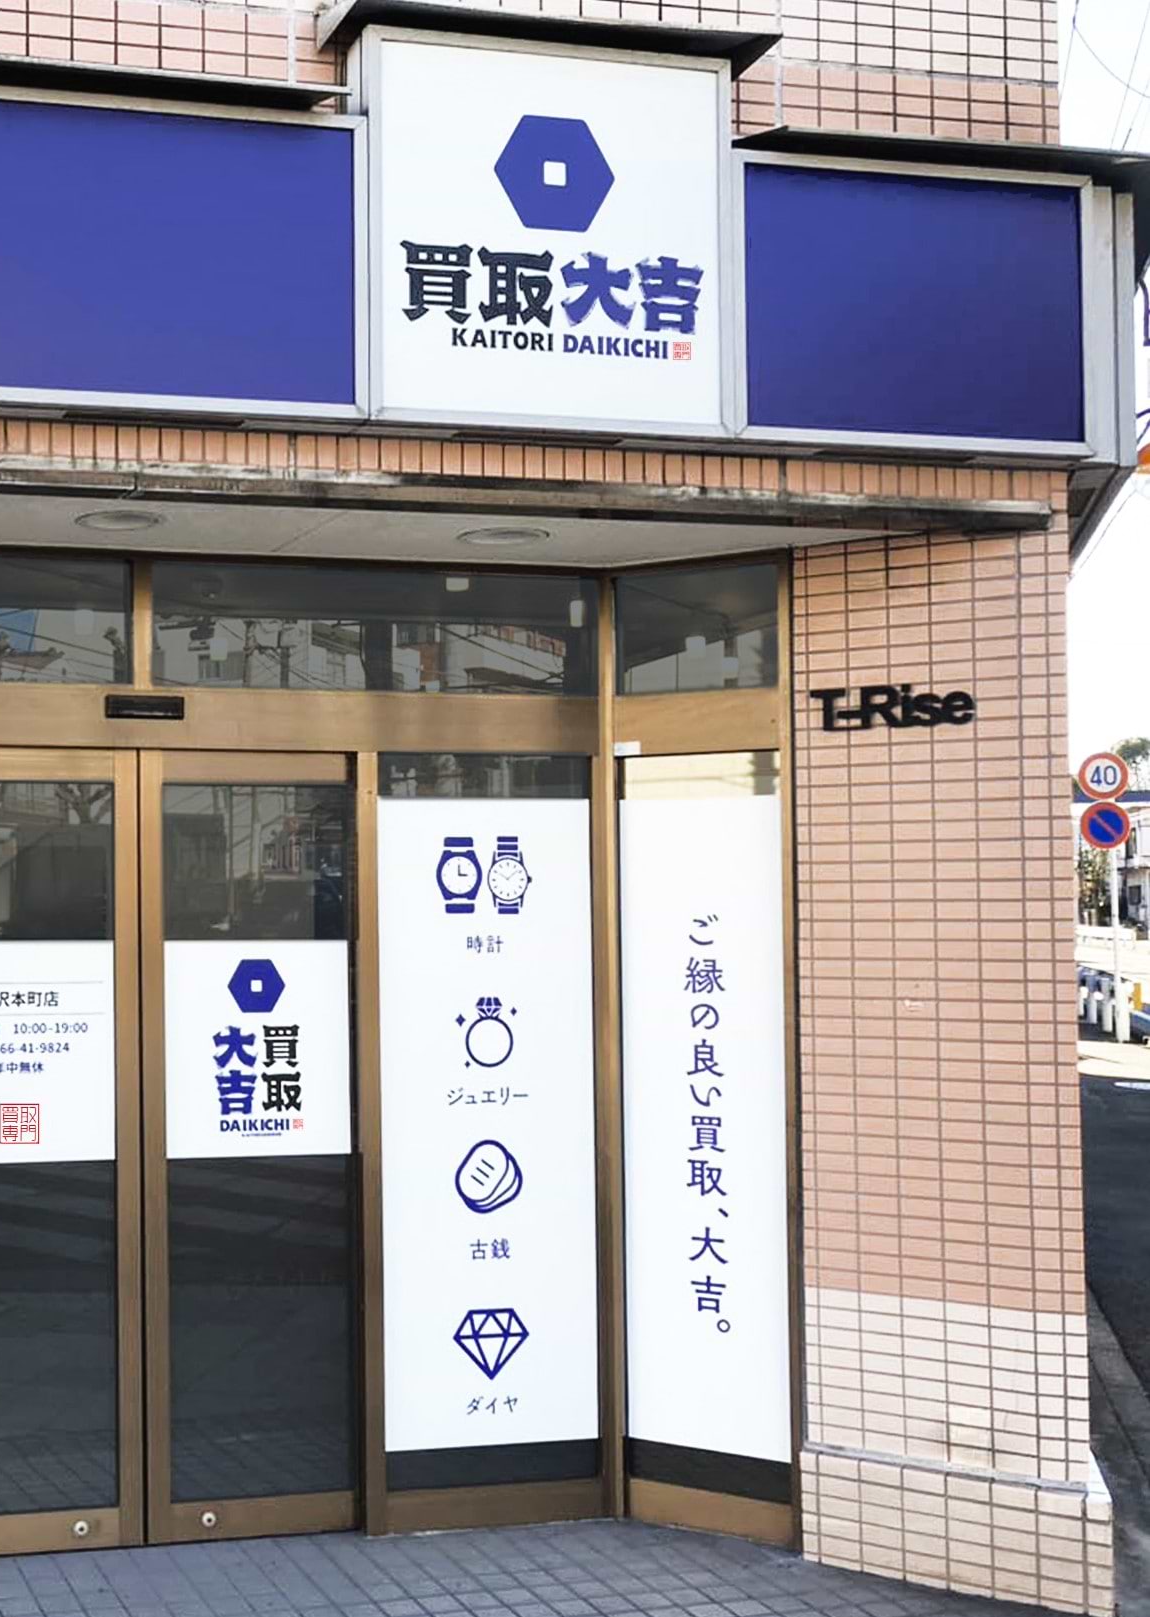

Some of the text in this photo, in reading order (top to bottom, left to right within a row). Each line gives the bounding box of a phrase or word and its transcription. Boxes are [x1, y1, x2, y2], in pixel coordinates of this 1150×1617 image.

[451, 328, 554, 352] KAITORI
[563, 334, 669, 359] DAIKICHI
[810, 684, 976, 732] T-Rise
[1089, 765, 1118, 787] 40
[466, 935, 504, 954] 時計
[212, 1025, 258, 1116] 大吉
[261, 1024, 303, 1112] 買取
[447, 1086, 529, 1106] ジュエリー
[219, 1119, 290, 1132] DAIKICHI
[684, 914, 731, 1334] ご縁の良い買取、大吉。
[469, 1238, 511, 1261] 古銭
[466, 1395, 518, 1415] ダイヤ
